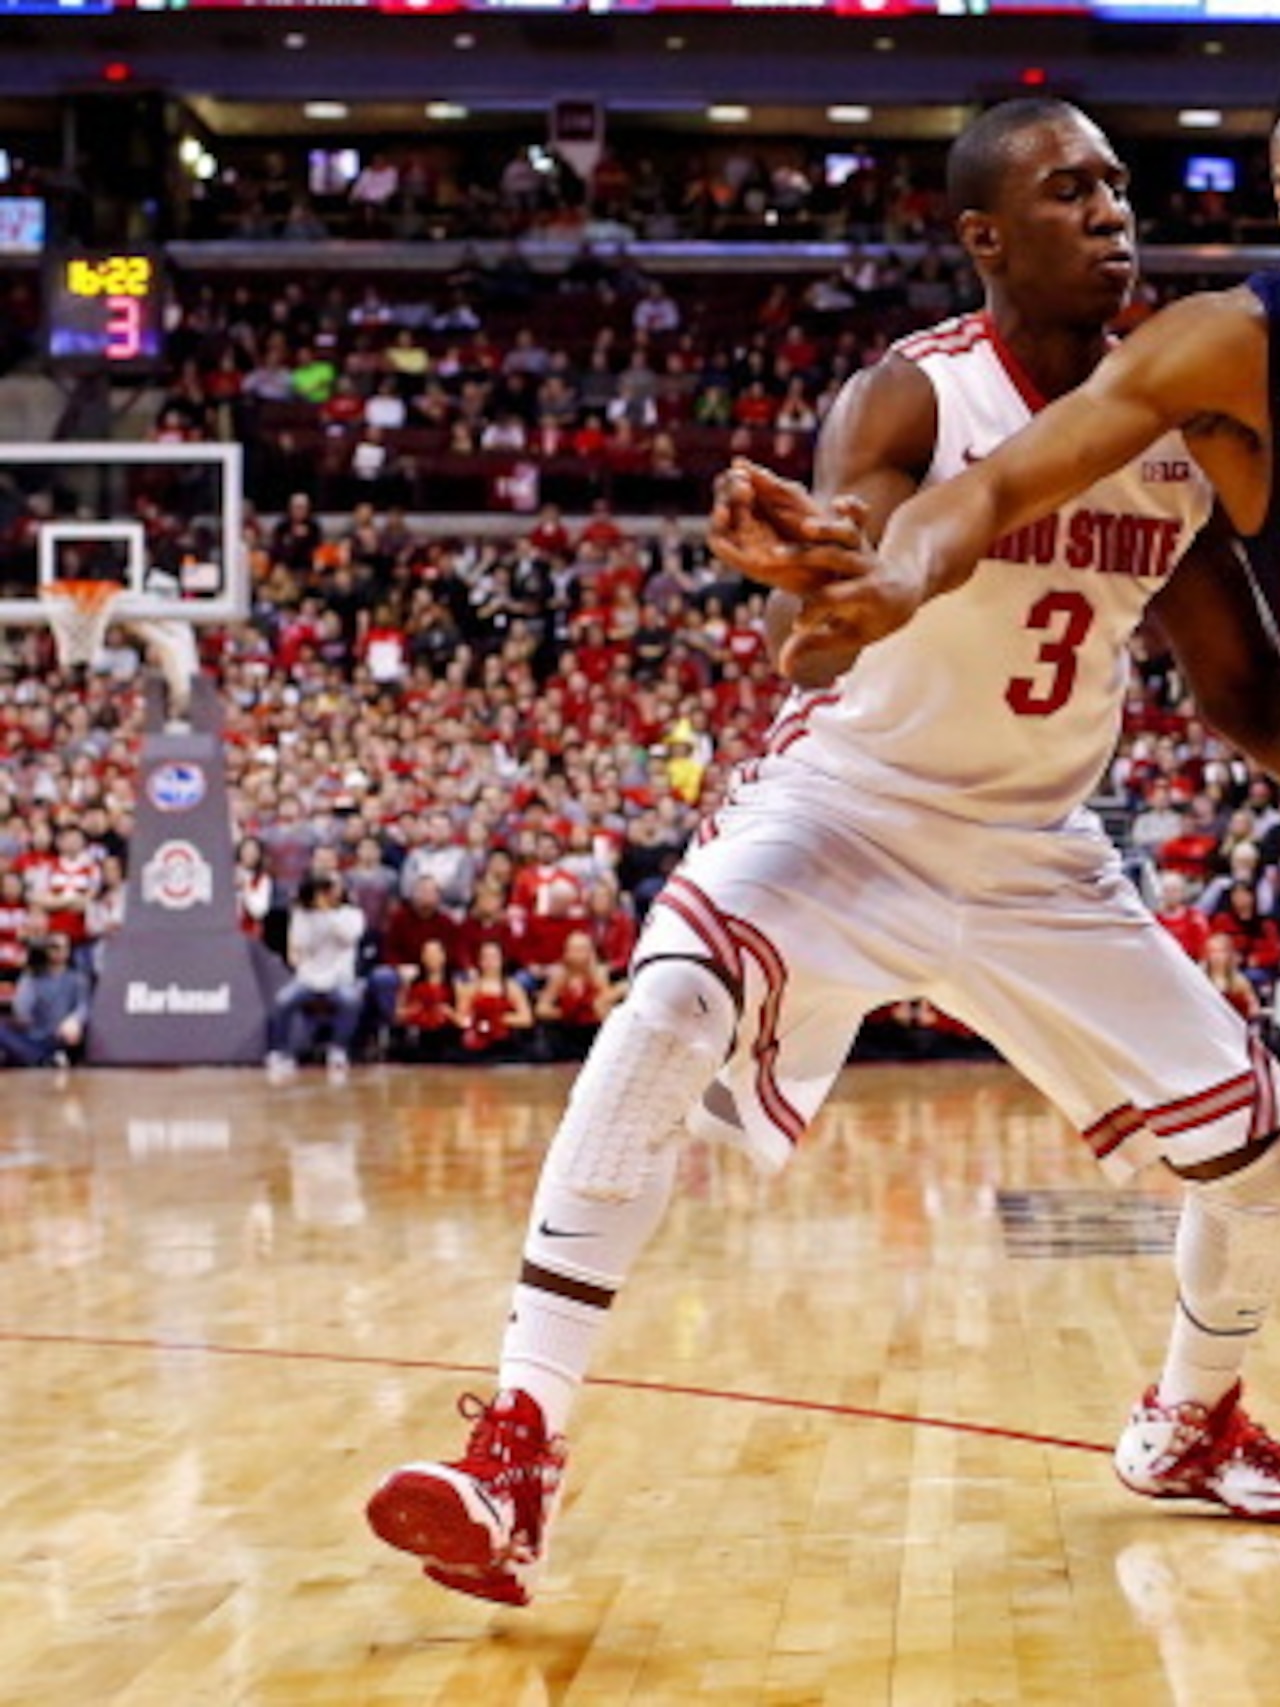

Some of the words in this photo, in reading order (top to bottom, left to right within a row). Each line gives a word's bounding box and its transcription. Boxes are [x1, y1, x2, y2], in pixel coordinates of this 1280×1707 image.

[106, 297, 139, 358] 3
[985, 512, 1059, 568] HIO
[1064, 509, 1184, 577] STATE
[1006, 591, 1095, 716] 3
